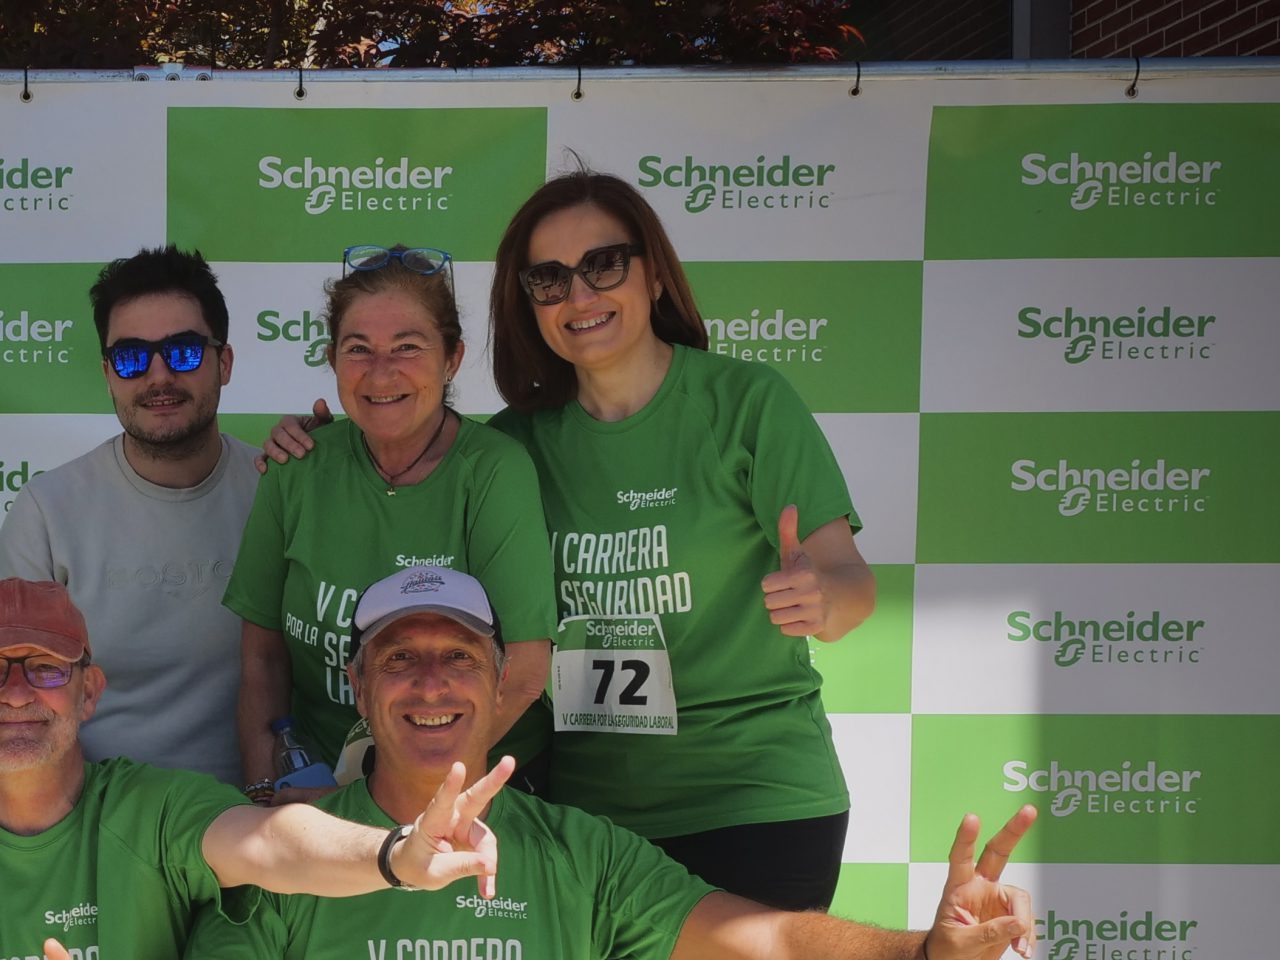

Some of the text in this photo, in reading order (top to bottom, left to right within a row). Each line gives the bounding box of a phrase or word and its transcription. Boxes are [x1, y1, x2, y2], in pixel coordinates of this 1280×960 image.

[258, 156, 452, 190] Schneider
[638, 155, 835, 188] Schneider
[1021, 152, 1221, 185] Schneider
[341, 192, 448, 211] Electric
[722, 190, 830, 210] Electric
[1107, 187, 1218, 206] Electric
[704, 309, 828, 340] neider
[1017, 307, 1215, 340] Schneider
[1101, 342, 1211, 360] Electric
[1011, 459, 1210, 492] Schneider
[617, 488, 677, 504] Schneider
[641, 499, 676, 508] Electric
[1097, 494, 1205, 513] Electric
[563, 525, 669, 574] CARRERA
[317, 581, 336, 622] V
[286, 612, 318, 646] POR LA
[586, 620, 656, 636] Schneider
[1006, 611, 1204, 643] Schneider
[613, 636, 654, 646] Electric
[1092, 645, 1199, 664] Electric
[592, 660, 651, 706] 72
[1003, 760, 1201, 793] Schneider
[1088, 794, 1197, 813] Electric
[456, 895, 528, 912] Schneider
[70, 917, 96, 927] Electr
[488, 909, 527, 919] Electric
